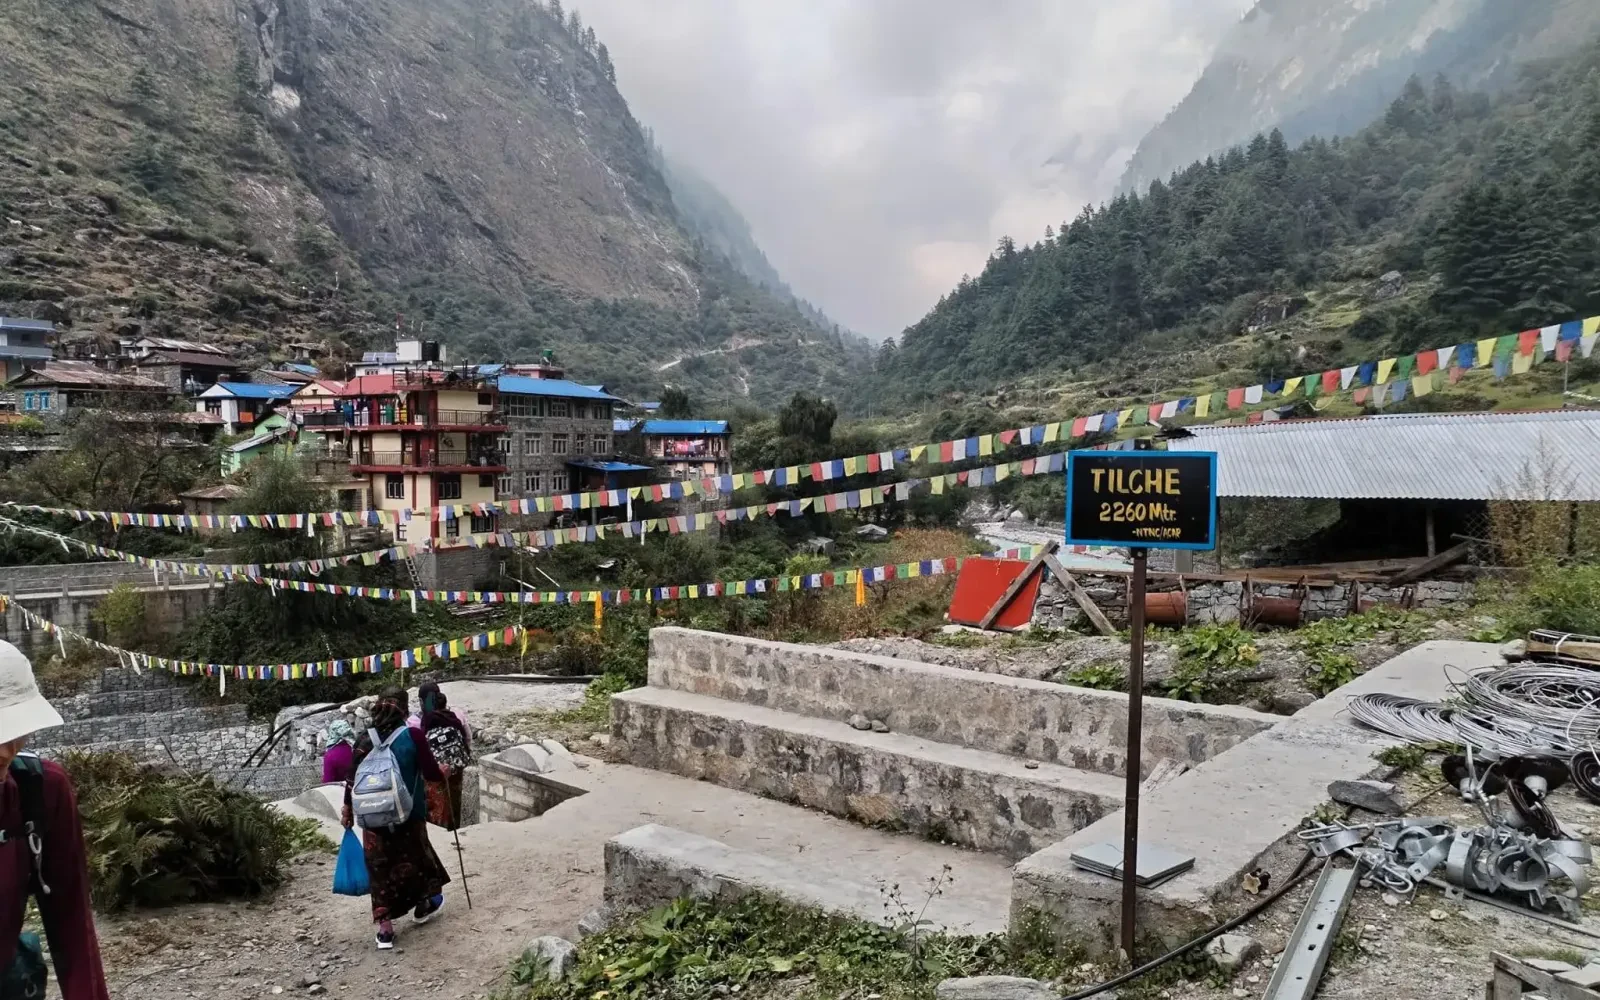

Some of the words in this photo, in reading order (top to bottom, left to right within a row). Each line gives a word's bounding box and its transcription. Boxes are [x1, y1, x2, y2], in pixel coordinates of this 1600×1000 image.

[1091, 468, 1181, 495] TILCHE
[1099, 502, 1147, 522] 2260
[1149, 502, 1177, 523] Mtr.
